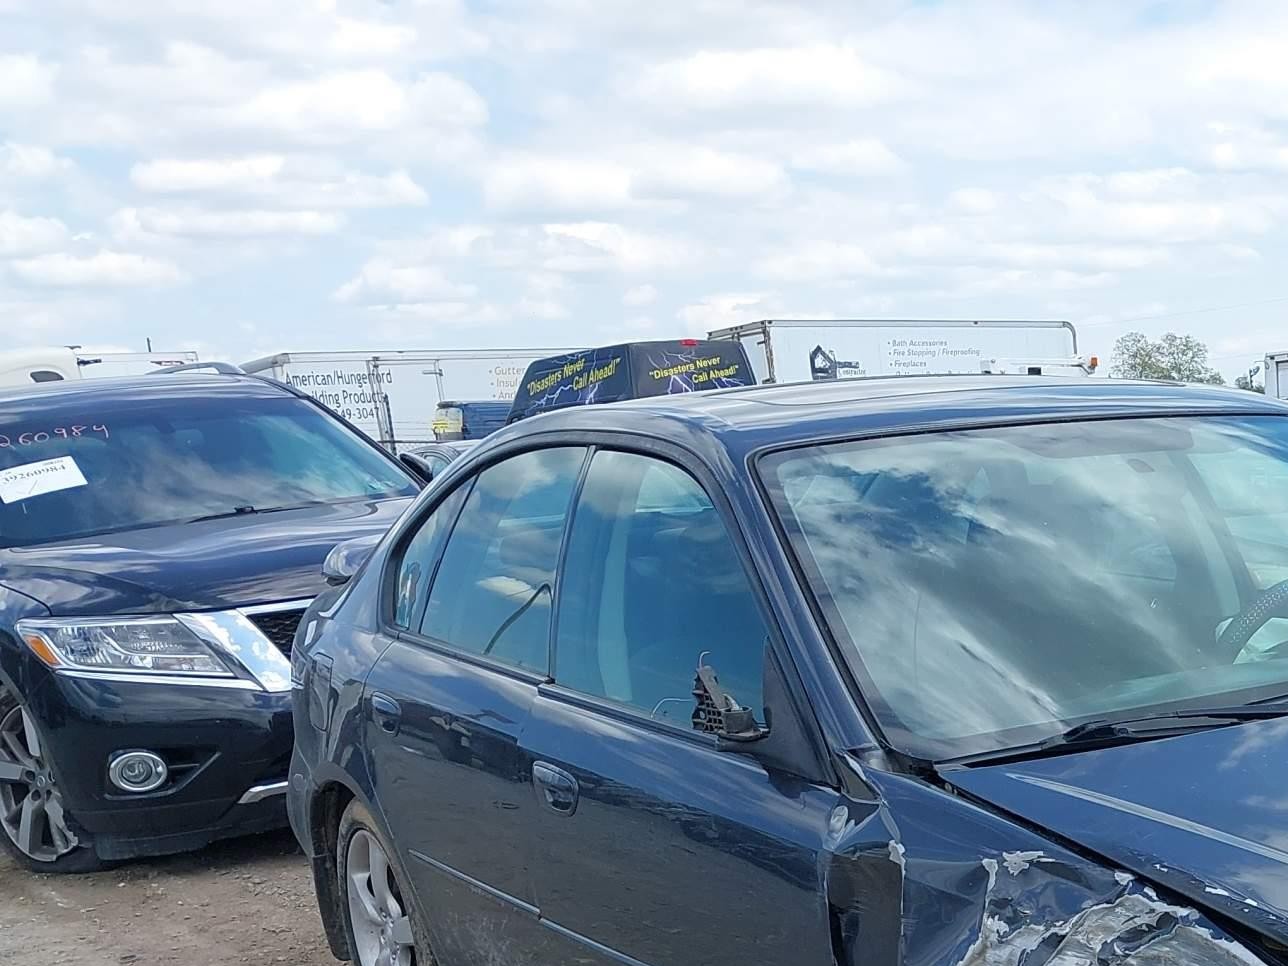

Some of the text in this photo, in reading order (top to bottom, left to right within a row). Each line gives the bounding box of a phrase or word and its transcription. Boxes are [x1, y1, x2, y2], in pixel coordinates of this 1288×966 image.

[891, 339, 948, 347] Bath Accessories
[893, 348, 905, 356] Fire
[907, 348, 936, 357] Stopping
[941, 347, 980, 356] Fireproofing
[563, 358, 586, 379] Never
[695, 357, 721, 369] Never
[894, 360, 927, 368] Fireplaces
[285, 369, 392, 388] American/Hungerford
[496, 377, 521, 387] Insul
[572, 372, 588, 391] Call
[691, 372, 709, 384] Call
[311, 390, 341, 408] ilding
